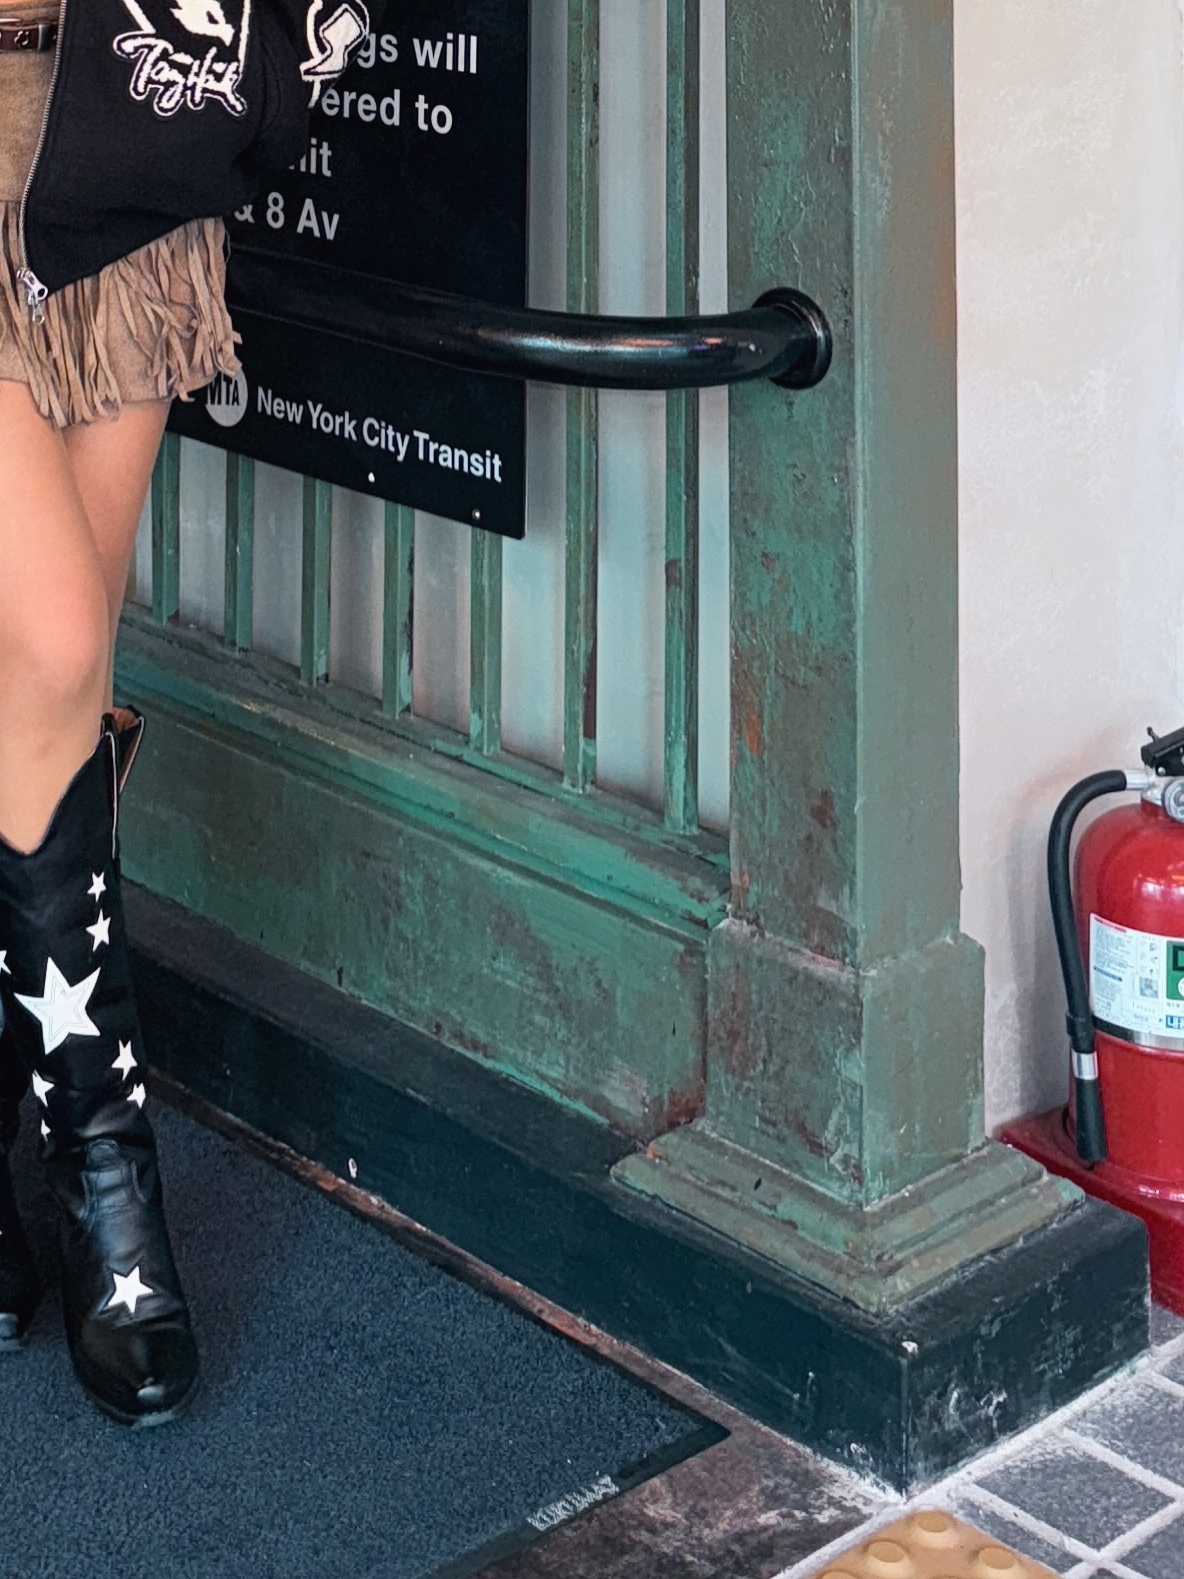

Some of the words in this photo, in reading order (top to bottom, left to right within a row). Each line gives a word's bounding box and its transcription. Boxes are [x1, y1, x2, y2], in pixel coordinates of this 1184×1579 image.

[413, 32, 478, 74] will
[321, 88, 402, 127] ered
[415, 94, 454, 135] to
[266, 191, 286, 230] 8
[296, 197, 340, 242] Av
[257, 385, 304, 425] New
[306, 399, 358, 442] York
[362, 417, 410, 463] City
[413, 429, 503, 484] Transit
